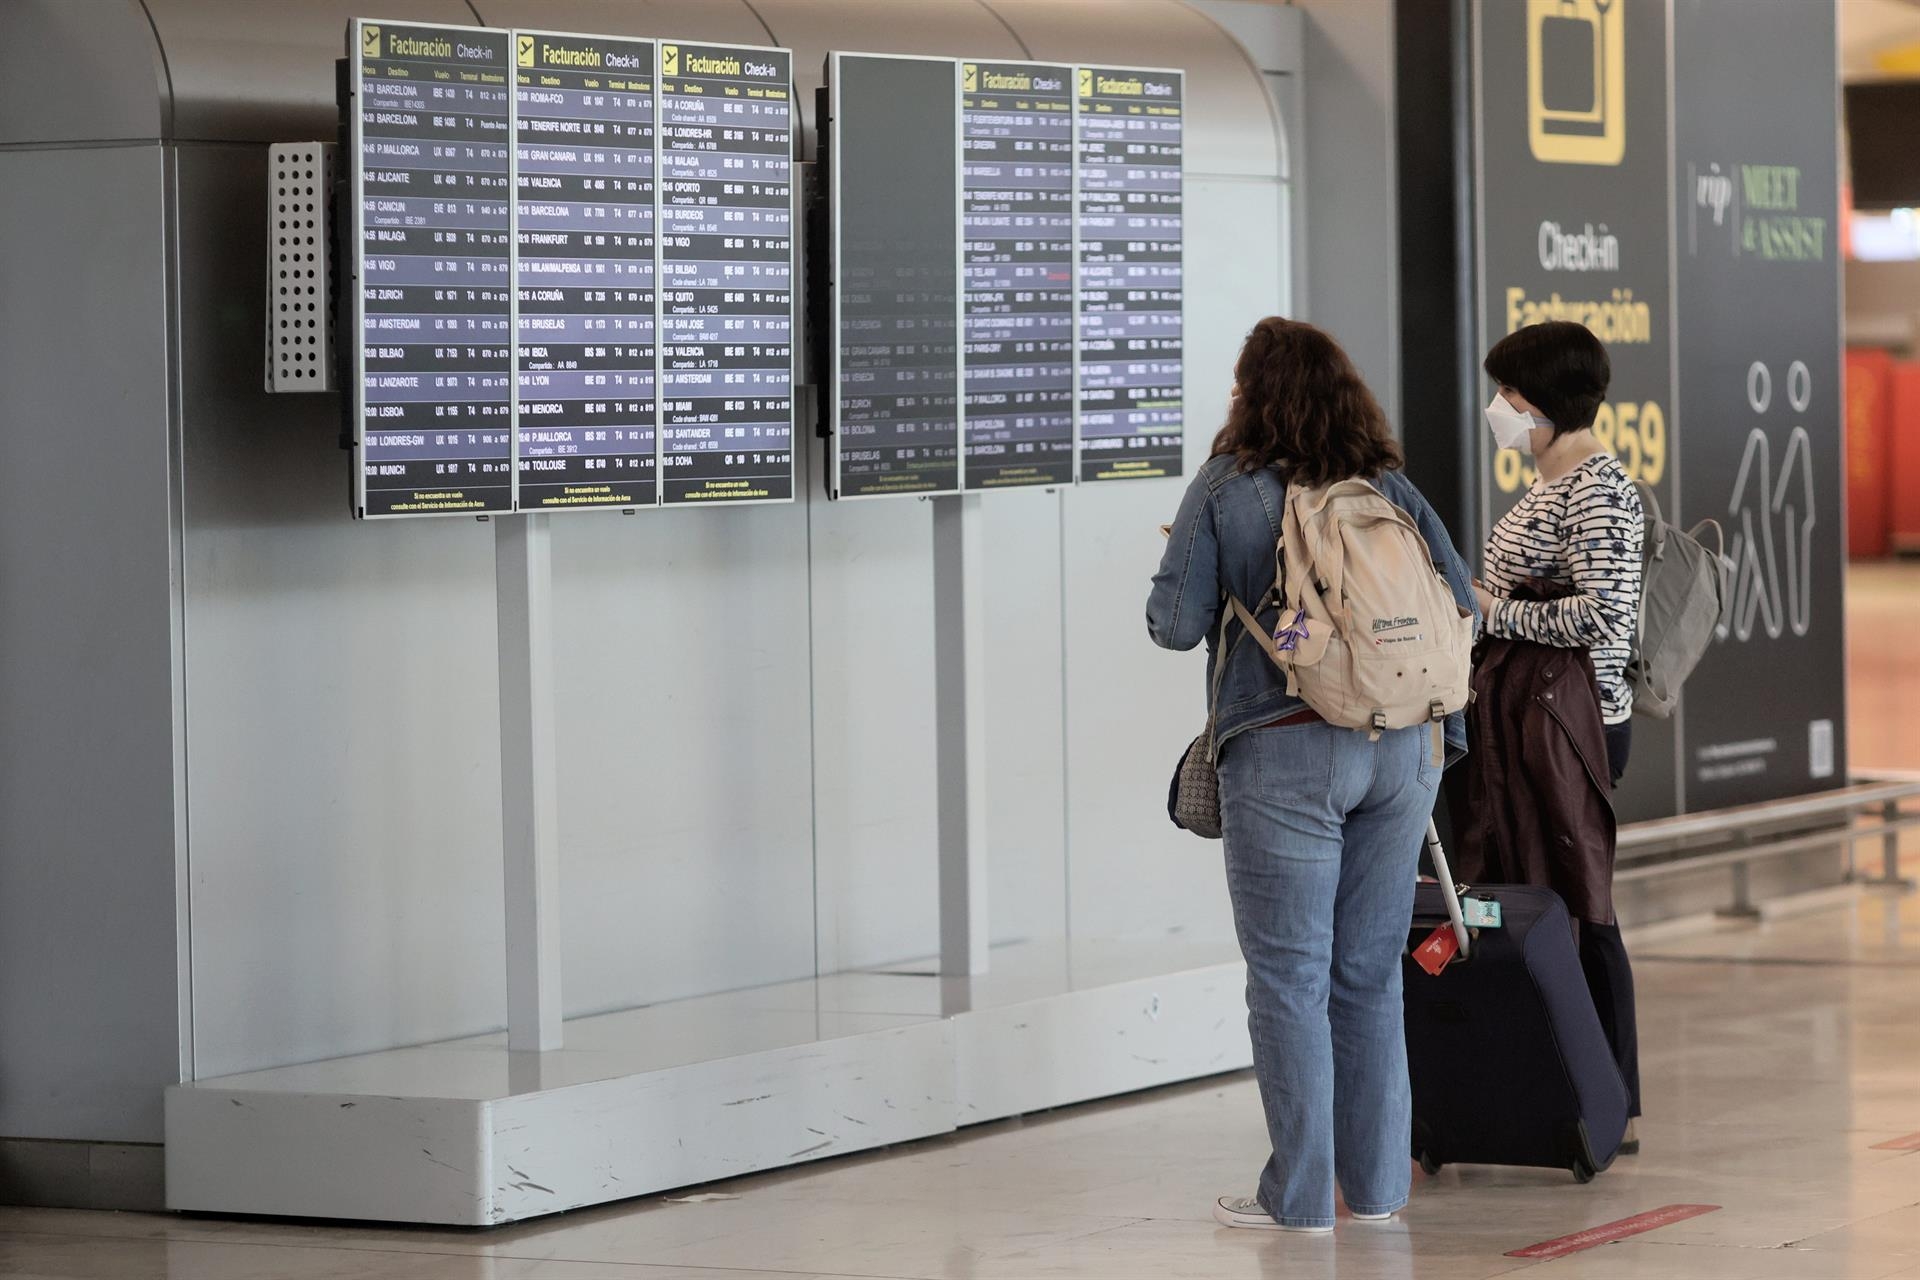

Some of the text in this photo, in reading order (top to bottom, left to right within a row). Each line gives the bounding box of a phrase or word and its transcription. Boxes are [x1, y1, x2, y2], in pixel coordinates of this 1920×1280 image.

[390, 35, 492, 59] Facturación Check-in
[543, 45, 639, 68] Facturación Check-in
[687, 54, 776, 76] Facturación Check-in
[541, 76, 560, 85] Destino
[983, 72, 1061, 90] Facturación Check-in
[1097, 77, 1171, 95] Facturación Check-in
[377, 84, 473, 99] BARCELONA IBE T4
[531, 93, 620, 107] ROMA-FCO UX T4
[680, 99, 704, 111] CORUÑA
[752, 105, 759, 114] T4
[377, 113, 473, 127] BARCELONA IBE T4
[531, 121, 621, 134] TENERIFE NORTE UX T4
[752, 132, 759, 141] T4
[377, 144, 420, 155] P.MALLORCA
[434, 147, 442, 156] UX
[466, 148, 473, 157] T4
[531, 150, 621, 163] GRAN CANARIA UX T4
[675, 156, 759, 168] MALAGA T4
[377, 172, 409, 183] ALICANTE
[434, 175, 442, 184] UX
[466, 176, 473, 185] T4
[531, 177, 621, 190] VALENCIA UX T4
[675, 182, 700, 192] OPORTO
[378, 201, 405, 212] CANCUN
[466, 204, 474, 214] T4
[531, 206, 621, 217] BARCELONA UX T4
[675, 210, 703, 220] BURDEOS
[378, 231, 474, 242] MALAGA UX T4
[532, 234, 621, 245] FRANKFURT UX T4
[675, 237, 690, 247] VIGO
[1538, 221, 1619, 271] Check-in
[378, 260, 395, 271] VIGO
[435, 262, 443, 271] UX
[467, 262, 474, 271] T4
[584, 264, 592, 273] UX
[614, 264, 621, 273] T4
[675, 265, 697, 274] BILBAO
[378, 289, 475, 300] ZURICH UX T4
[538, 289, 564, 301] CORUÑA
[585, 292, 592, 301] UX
[614, 292, 622, 301] T4
[675, 292, 694, 302] QUITO
[379, 319, 475, 329] AMSTERDAM UX T4
[532, 319, 622, 329] BRUSELAS UX T4
[676, 319, 704, 329] SAN JOSE
[379, 348, 475, 358] BILBAO UX T4
[615, 347, 622, 356] T4
[675, 347, 704, 356] VALENCIA
[379, 377, 475, 387] LANZAROTE UX T4
[532, 375, 622, 385] LYON T4
[675, 374, 711, 383] AMSTERDAM
[380, 406, 475, 417] LISBOA UX T4
[532, 403, 622, 414] MENORCA T4
[532, 431, 622, 442] P.MALLORCA T4
[676, 428, 710, 438] SANTANDER
[380, 435, 475, 446] LONDRES-GW UX T4
[676, 454, 760, 465] DOHA T4
[852, 451, 880, 460] BRUSELAS
[380, 463, 476, 475] MUNICH UX T4
[532, 459, 623, 470] TOULOUSE T4
